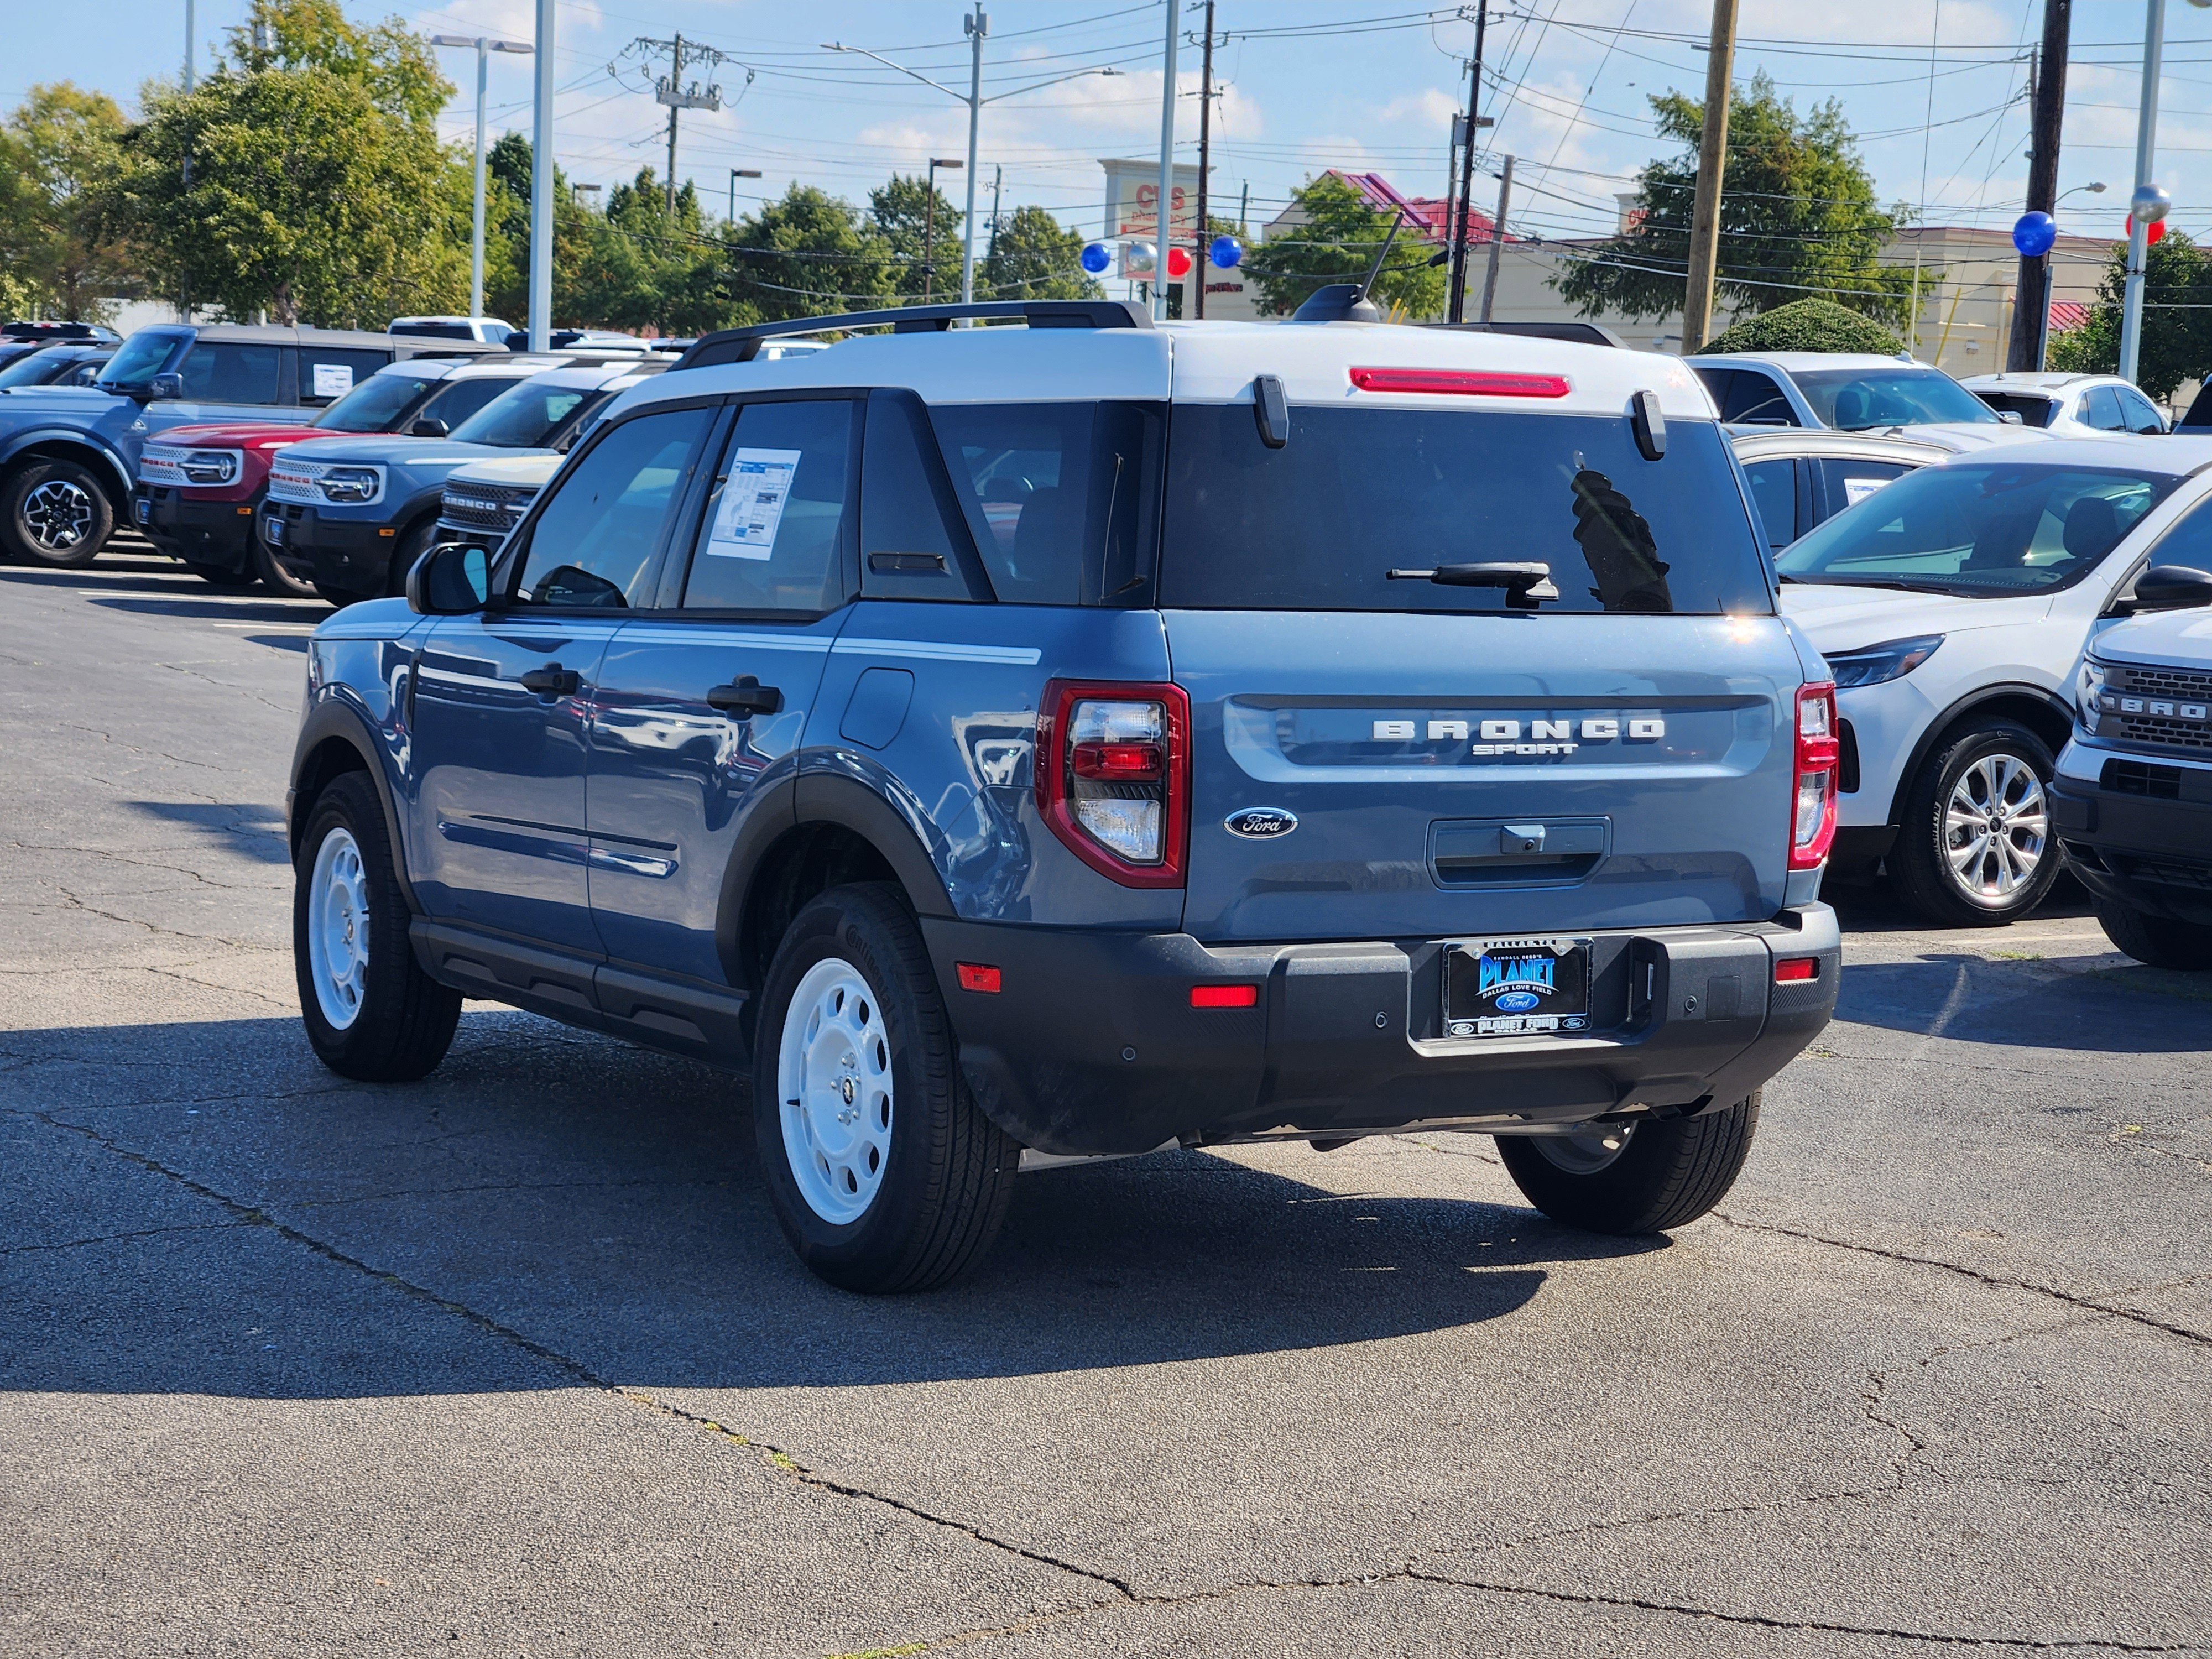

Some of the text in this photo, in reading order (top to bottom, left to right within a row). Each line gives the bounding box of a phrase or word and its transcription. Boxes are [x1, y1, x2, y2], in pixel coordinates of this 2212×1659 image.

[444, 496, 496, 510] BRONCO
[2120, 698, 2207, 719] BRO
[1373, 719, 1665, 740] BRONCO
[1472, 743, 1579, 756] SPORT
[1241, 813, 1283, 832] Ford
[1479, 955, 1556, 993] PLANET
[1482, 987, 1510, 999] DALLAS
[1532, 986, 1552, 995] FIELD
[1504, 994, 1531, 1009] Ford
[1477, 1018, 1558, 1034] PLANET FORD
